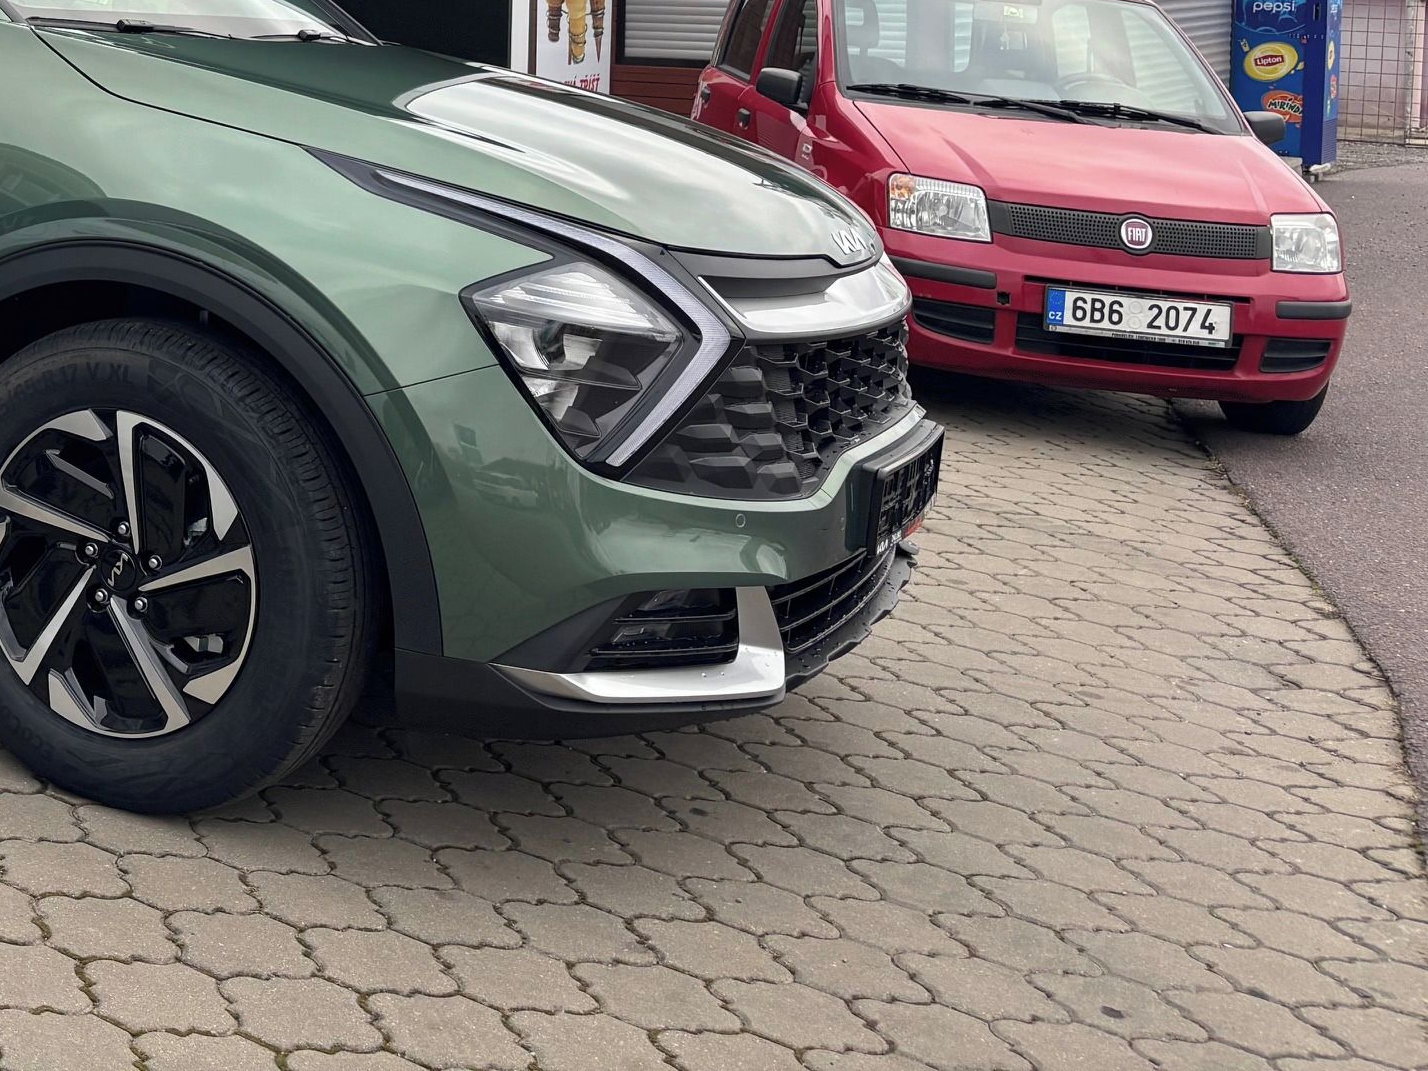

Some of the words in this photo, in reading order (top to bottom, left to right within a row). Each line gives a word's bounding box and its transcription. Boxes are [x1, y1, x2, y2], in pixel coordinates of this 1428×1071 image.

[1253, 0, 1296, 14] pepsi
[1256, 56, 1283, 66] Lipton
[1127, 227, 1147, 242] FIAT
[1048, 311, 1063, 321] CZ
[1071, 296, 1124, 326] 6B6
[1146, 303, 1217, 335] 2074
